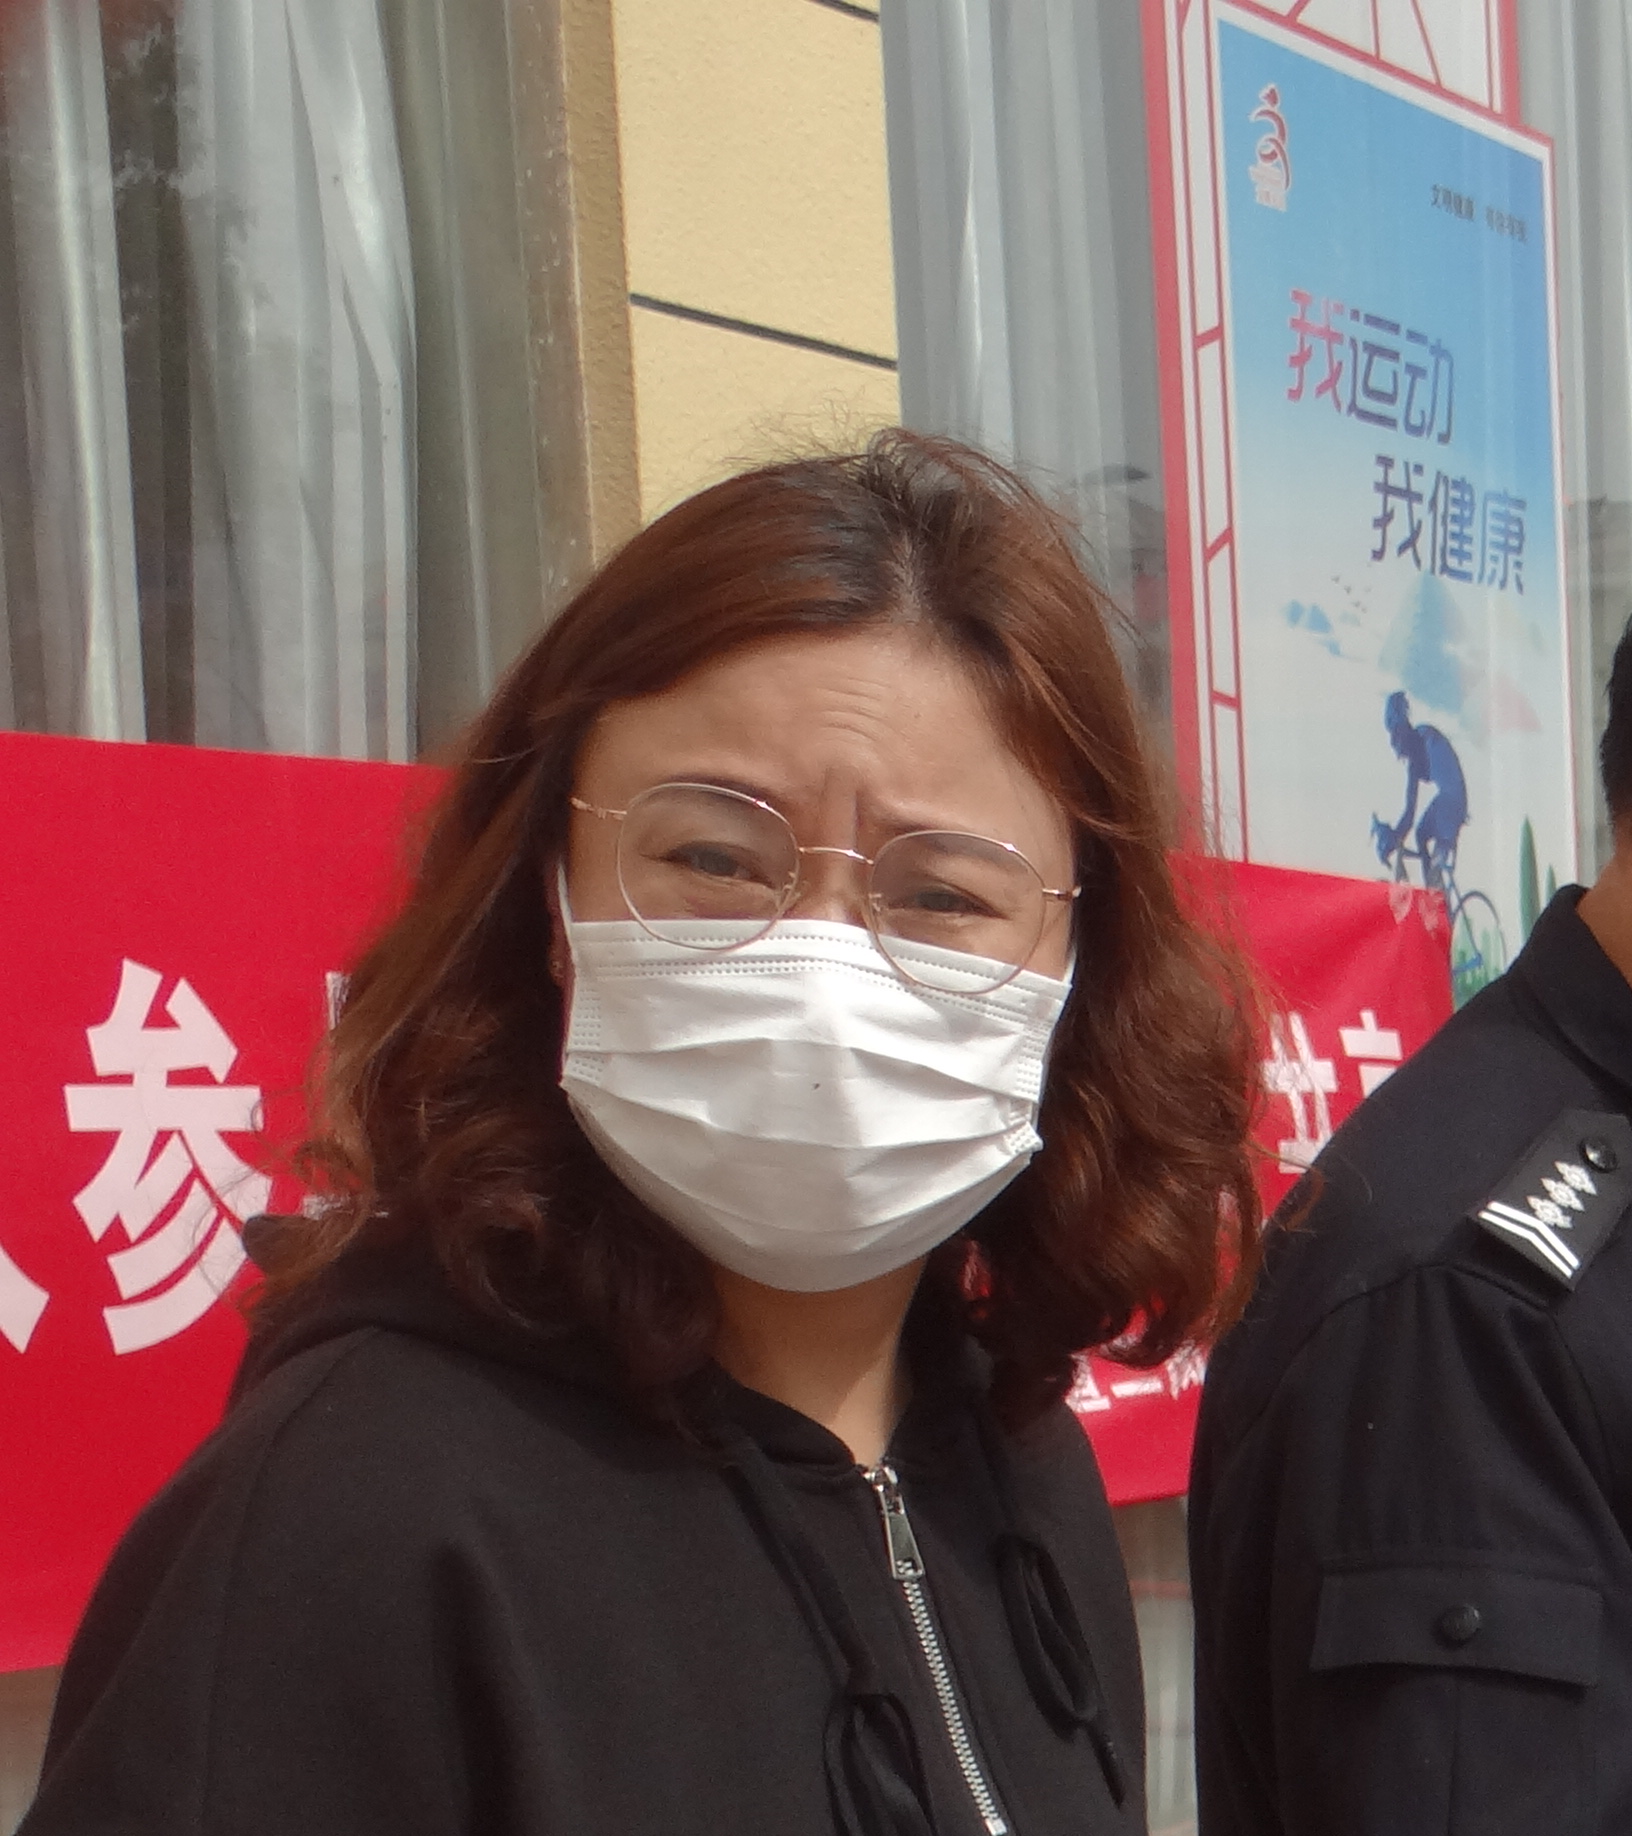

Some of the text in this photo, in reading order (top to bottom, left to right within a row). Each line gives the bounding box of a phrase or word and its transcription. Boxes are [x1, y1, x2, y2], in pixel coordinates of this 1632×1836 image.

[1288, 288, 1453, 444] 我运动
[1371, 454, 1527, 595] 我健康
[0, 957, 273, 1356] 参
